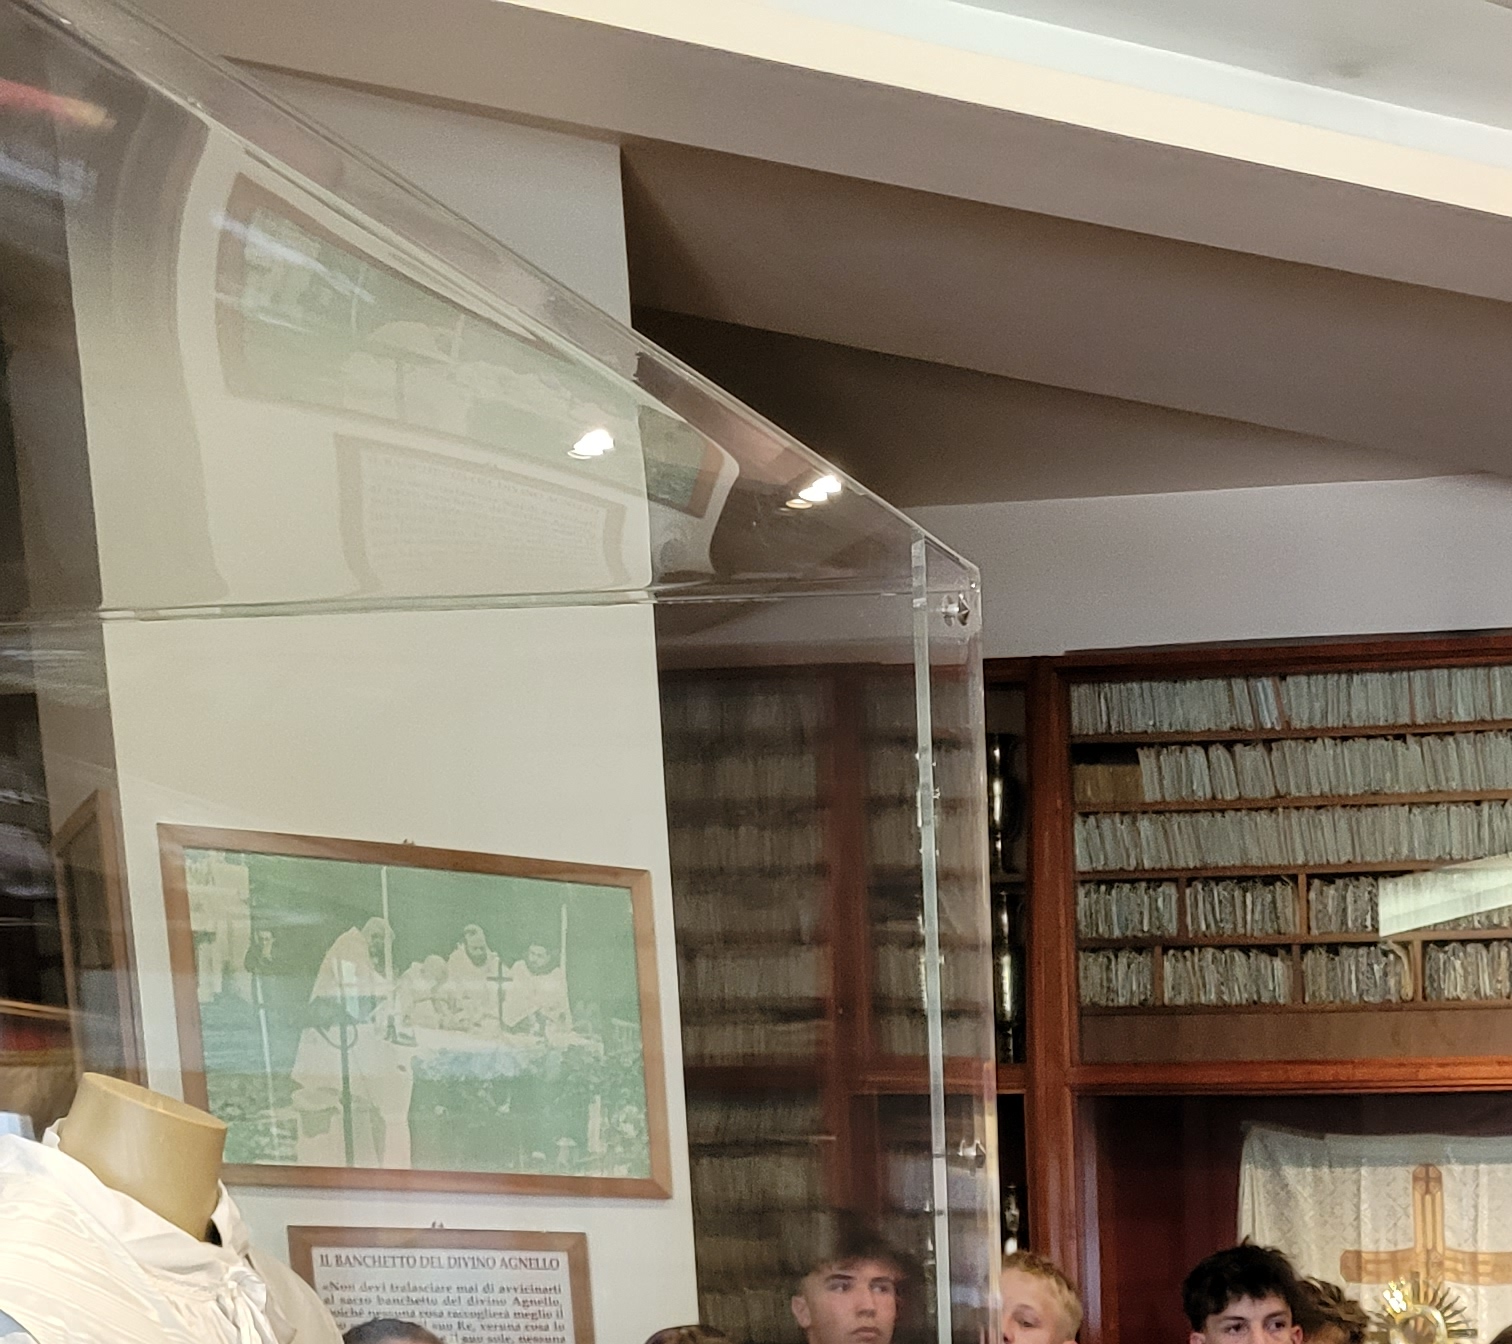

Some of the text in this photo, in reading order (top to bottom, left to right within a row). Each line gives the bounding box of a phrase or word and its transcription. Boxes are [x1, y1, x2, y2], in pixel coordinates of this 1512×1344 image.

[320, 1254, 560, 1271] IL BANCHETTO DEL DIVINO AGNELLO
[456, 1283, 478, 1294] mai
[482, 1283, 494, 1294] di
[498, 1284, 561, 1295] avvicinarti
[376, 1294, 438, 1306] banchetto
[442, 1295, 461, 1307] del
[467, 1296, 507, 1307] divino
[513, 1309, 553, 1321] meglio
[556, 1307, 563, 1319] il
[525, 1323, 550, 1332] cosa
[554, 1321, 565, 1332] lo
[519, 1335, 566, 1344] nessuna
